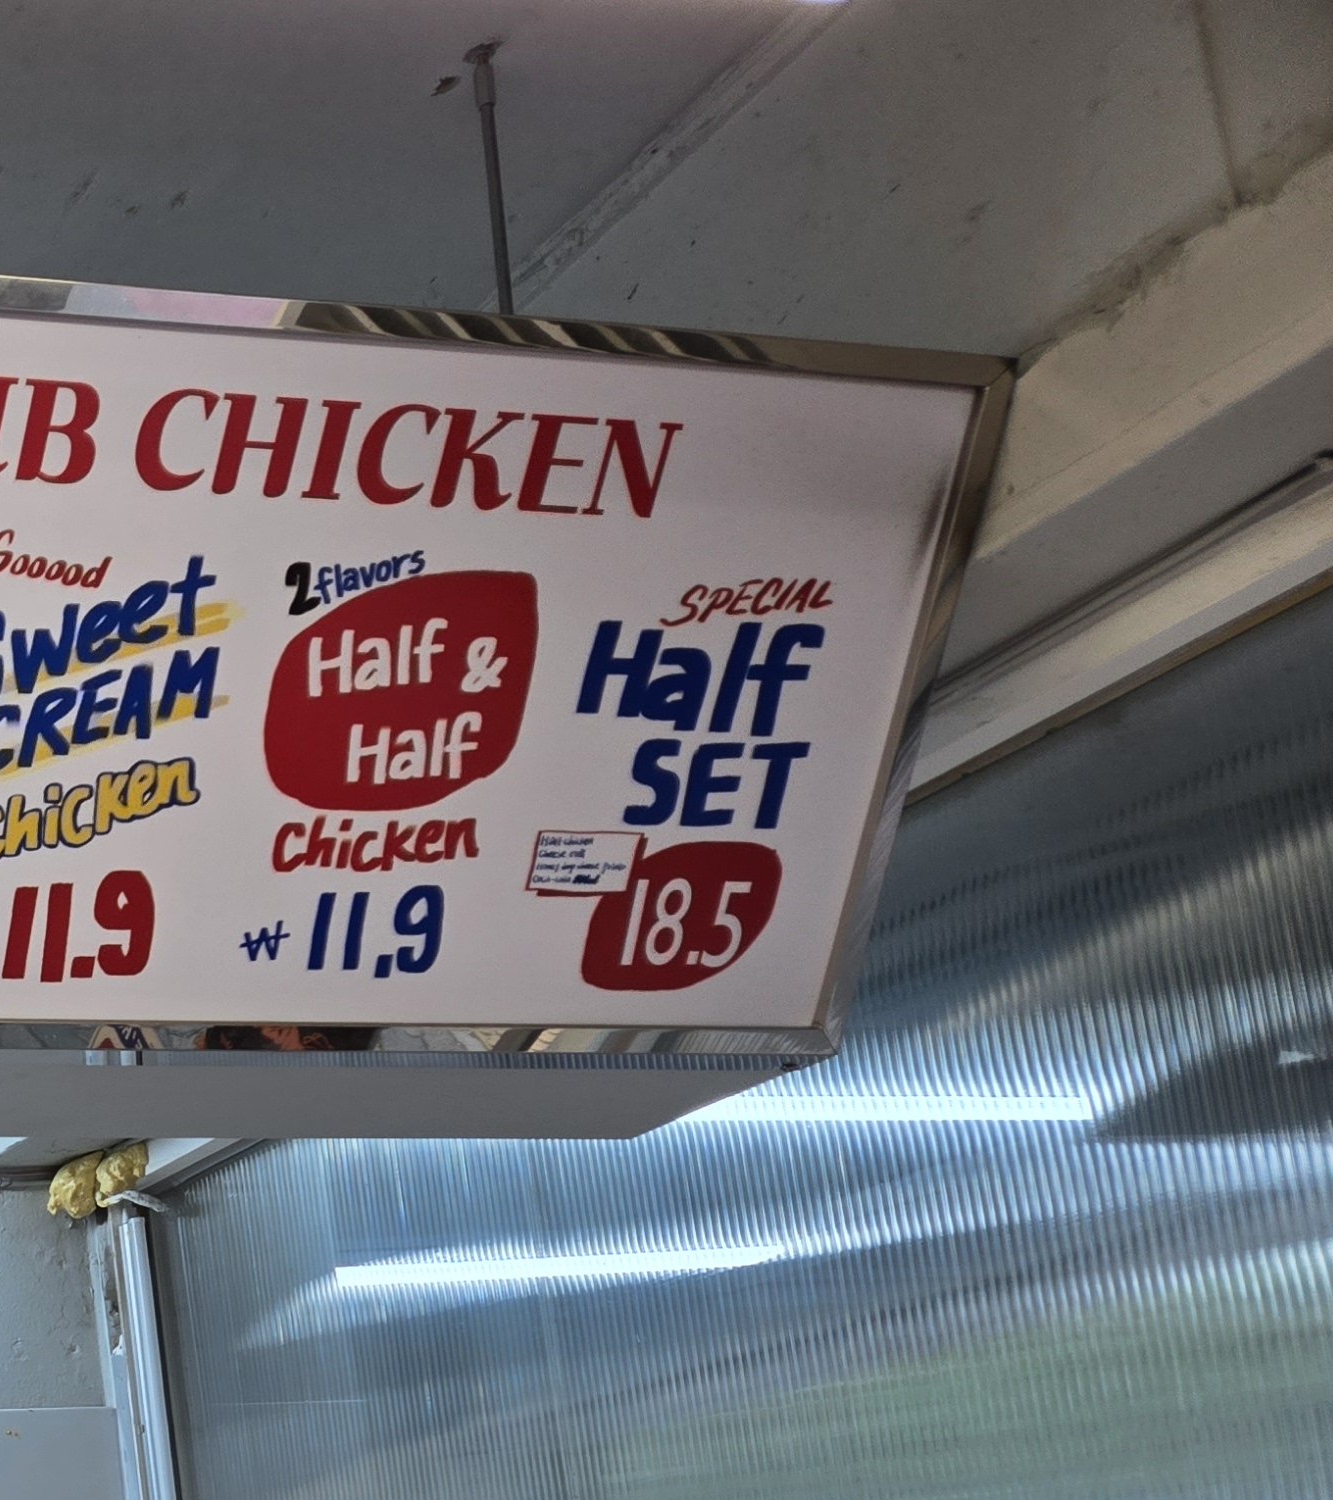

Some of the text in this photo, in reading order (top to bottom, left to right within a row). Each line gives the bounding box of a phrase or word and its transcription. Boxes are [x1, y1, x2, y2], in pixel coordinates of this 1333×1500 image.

[134, 387, 684, 519] CHICKEN
[659, 577, 834, 628] SPECIAL
[306, 618, 509, 699] Half &
[575, 619, 826, 737] Half
[345, 711, 483, 785] Half
[622, 738, 812, 830] SET
[271, 814, 480, 873] Chicken
[620, 878, 753, 968] 18.5
